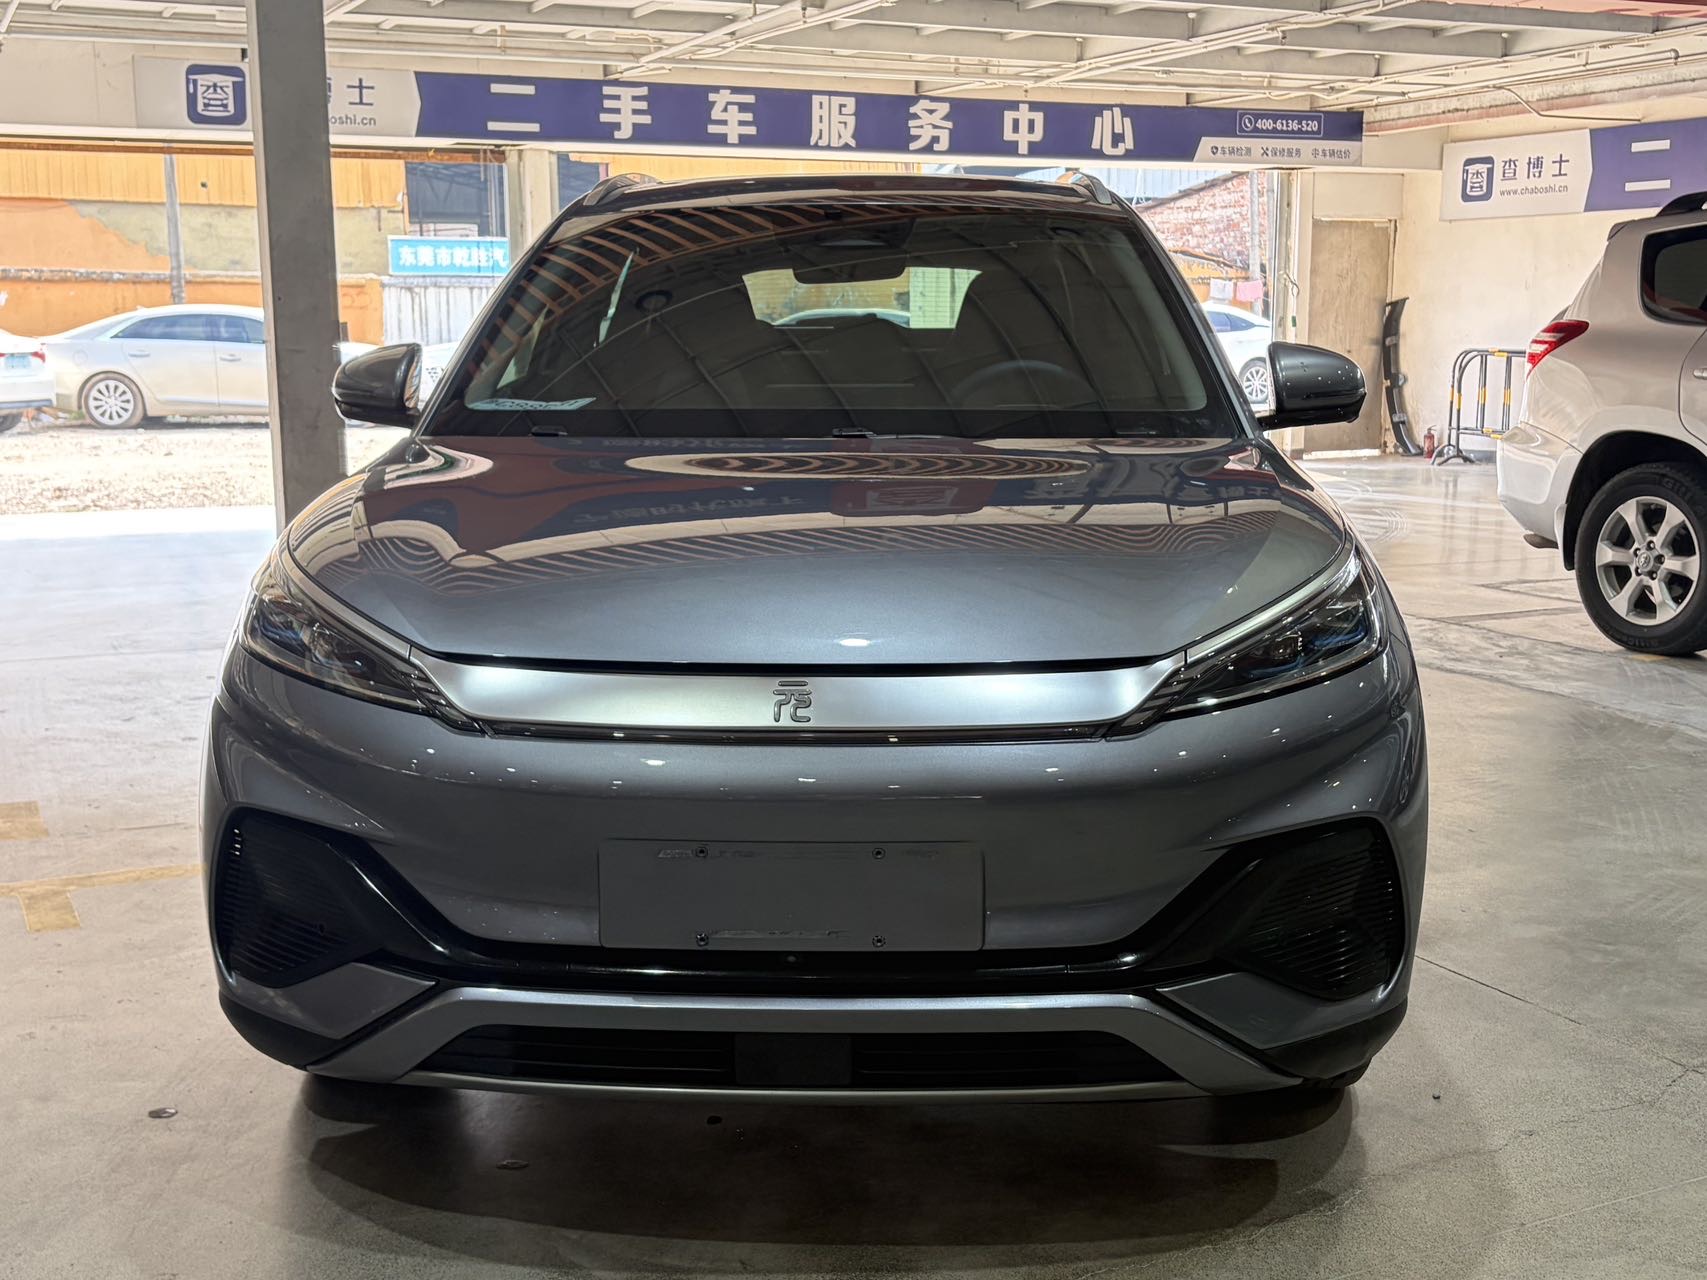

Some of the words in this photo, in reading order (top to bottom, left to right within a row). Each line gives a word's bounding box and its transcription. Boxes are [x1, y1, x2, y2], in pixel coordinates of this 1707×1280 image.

[329, 114, 376, 126] oshi.cn
[487, 83, 1134, 156] 二手车服务中心
[1255, 118, 1319, 132] 400-6136-520
[1220, 145, 1252, 158] 车辆检测
[1270, 147, 1302, 159] 保修服务
[1320, 148, 1351, 160] 车辆估价
[1500, 153, 1570, 181] 查博士
[1625, 139, 1671, 192] 二
[1500, 184, 1568, 197] www.chaboshi.cn
